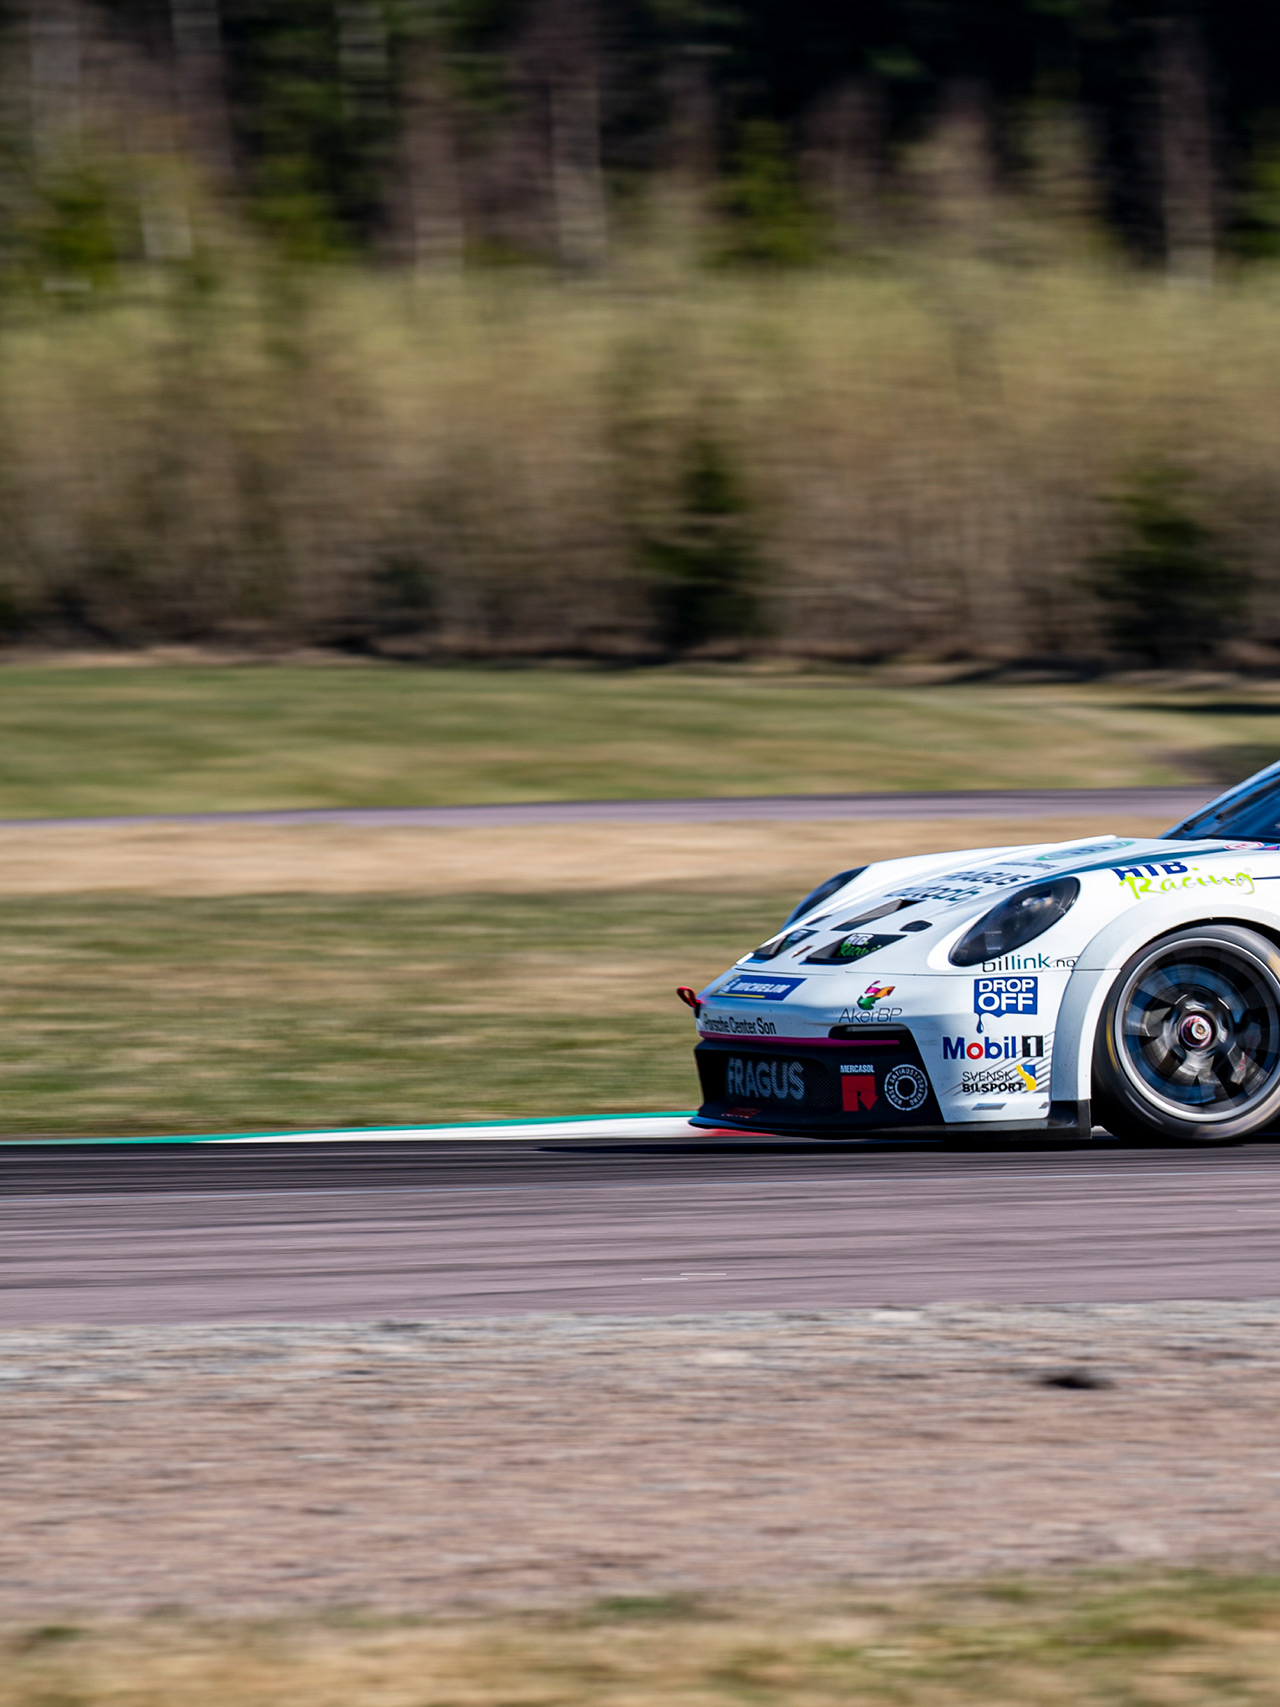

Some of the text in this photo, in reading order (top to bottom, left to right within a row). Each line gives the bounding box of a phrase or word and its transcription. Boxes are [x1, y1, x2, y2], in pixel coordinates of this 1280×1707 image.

[1111, 861, 1188, 880] HTB
[1119, 867, 1255, 900] Racing
[978, 979, 1035, 992] DROP
[978, 993, 1034, 1011] OFF
[703, 1013, 777, 1035] Porsche Center Son
[943, 1036, 1040, 1060] Mobil 1
[840, 1064, 875, 1073] MERCASOL
[962, 1070, 1013, 1082] SVENSK
[727, 1057, 805, 1100] FRAGUS
[962, 1082, 1025, 1093] BILSPORT
